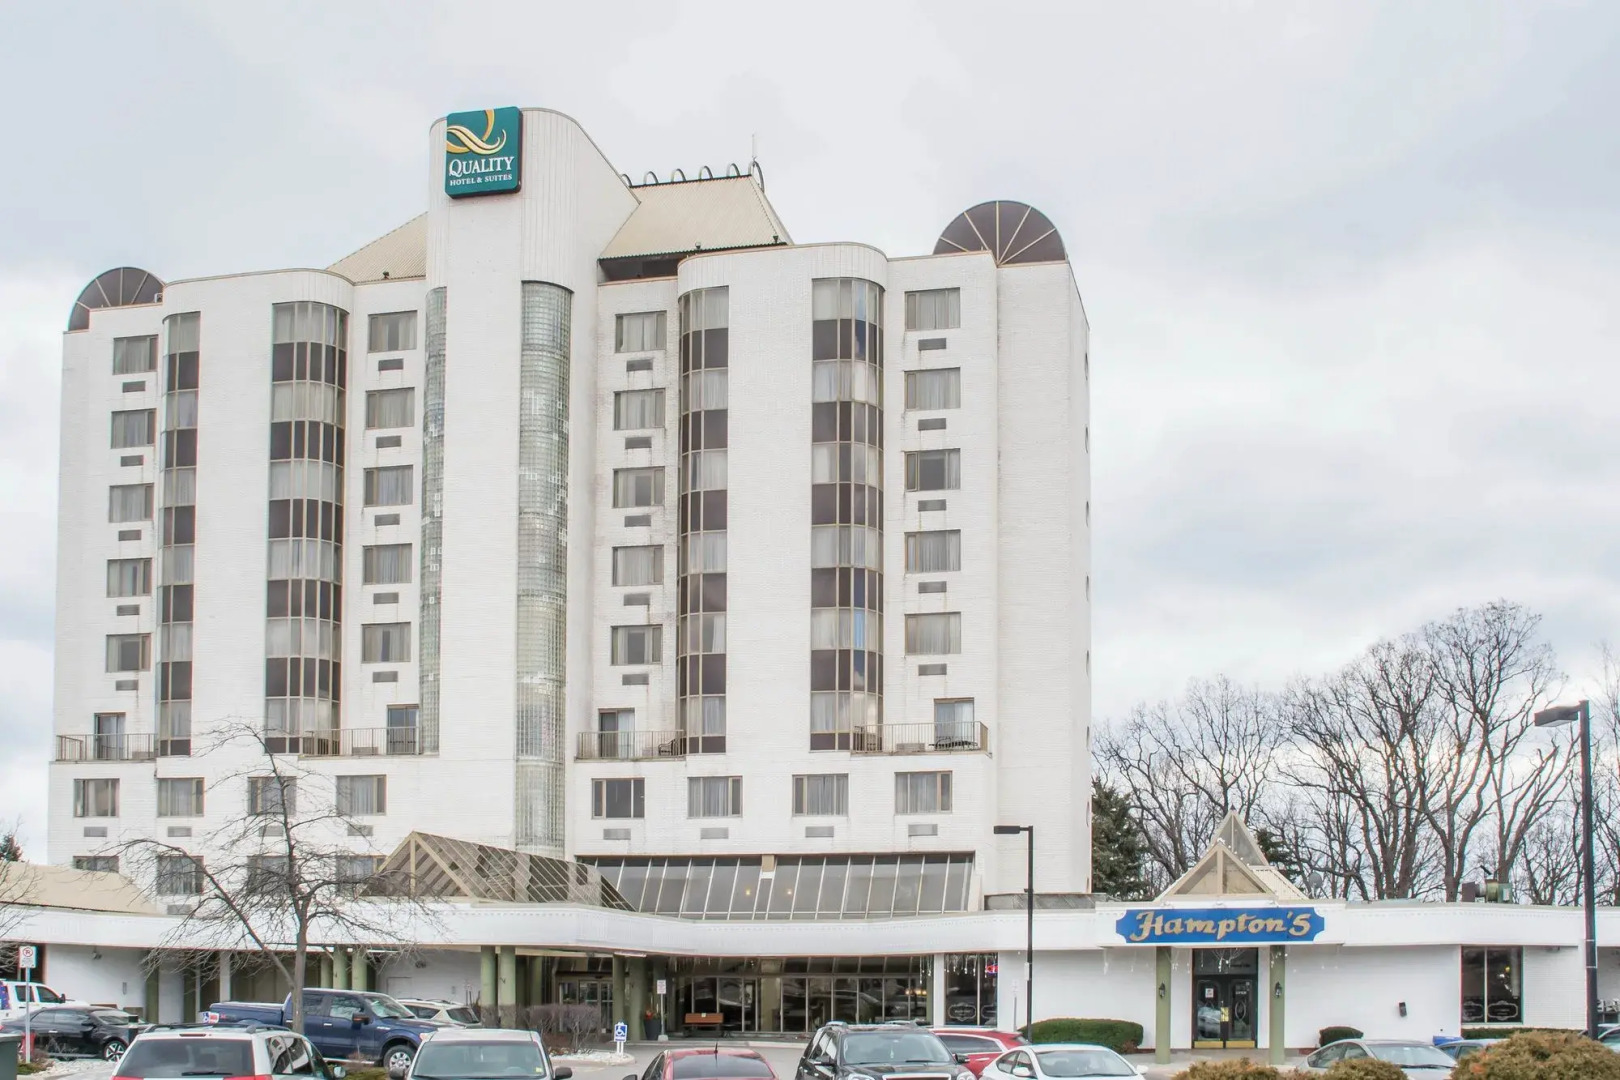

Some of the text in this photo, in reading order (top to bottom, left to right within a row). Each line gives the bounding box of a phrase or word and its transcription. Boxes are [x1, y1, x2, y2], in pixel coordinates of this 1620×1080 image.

[449, 156, 514, 177] QUALITY
[450, 178, 476, 186] HOTEL
[485, 174, 512, 182] SUITES
